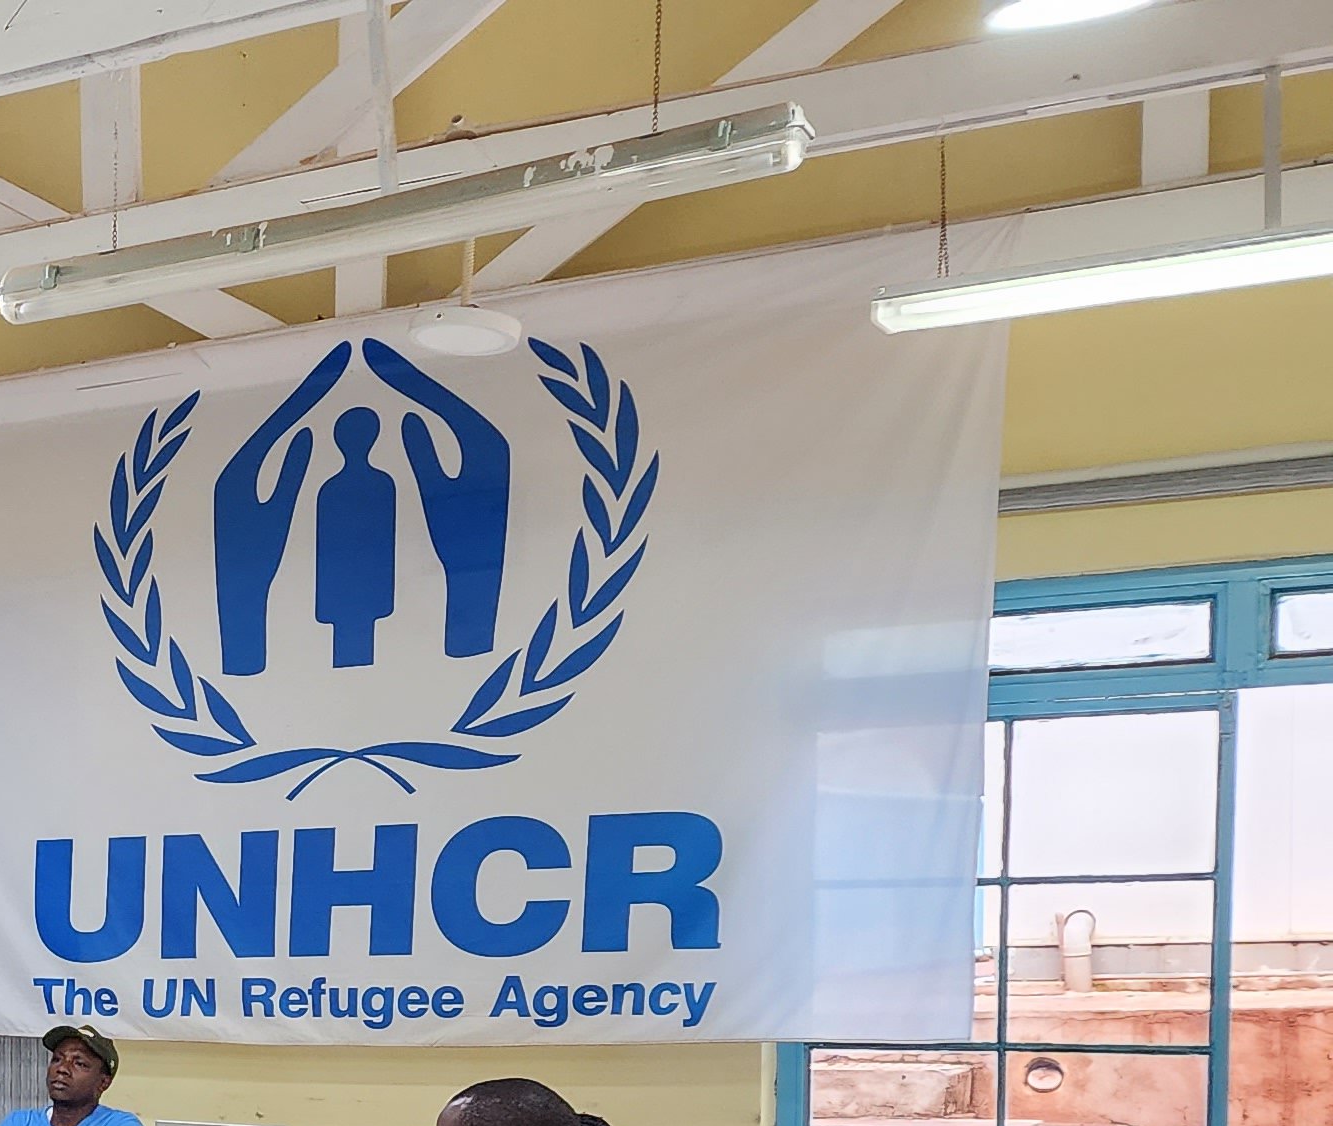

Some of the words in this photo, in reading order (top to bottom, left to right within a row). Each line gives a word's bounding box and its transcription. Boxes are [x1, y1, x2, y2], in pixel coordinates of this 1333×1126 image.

[34, 812, 723, 964] UNHCR
[33, 978, 119, 1017] The
[142, 978, 217, 1019] UN
[241, 977, 464, 1030] Refugee
[489, 976, 717, 1028] Agency
